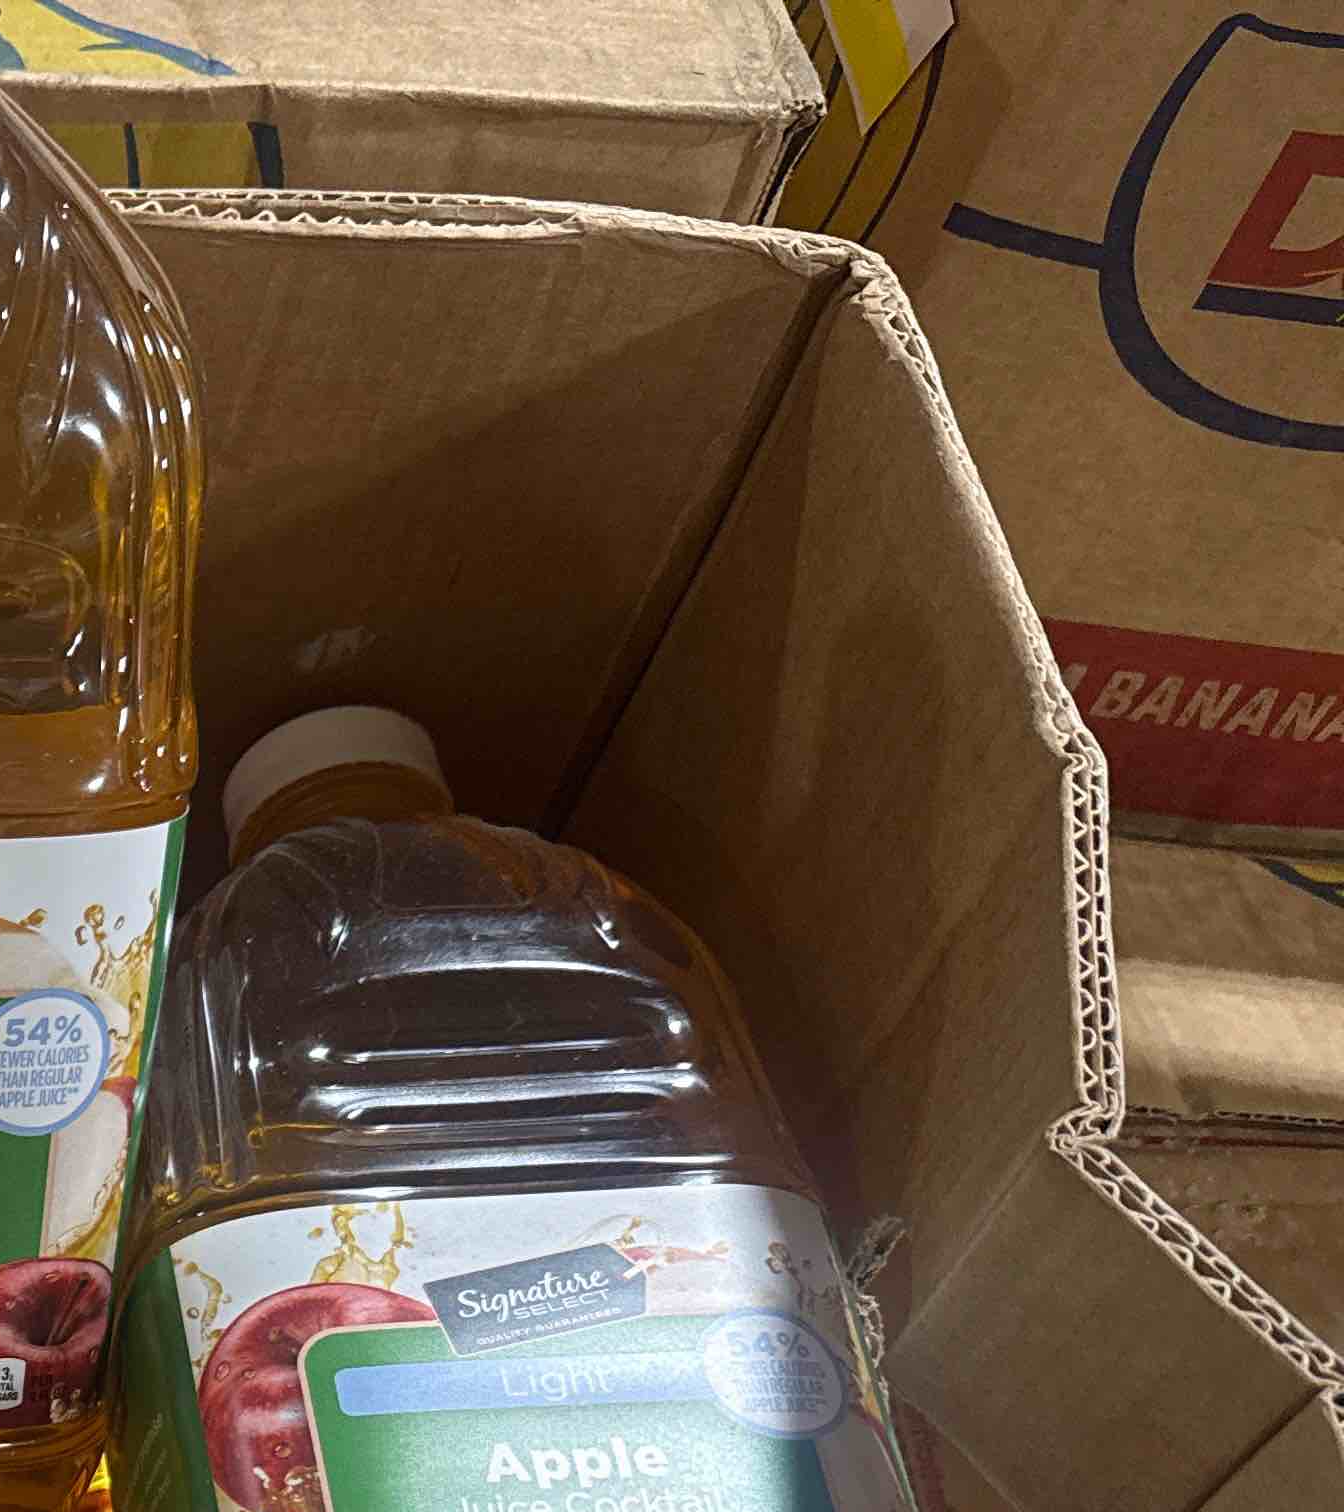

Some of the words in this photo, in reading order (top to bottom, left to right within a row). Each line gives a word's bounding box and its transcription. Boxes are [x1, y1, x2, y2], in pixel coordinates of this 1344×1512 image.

[3, 1015, 81, 1047] 54%
[36, 1044, 89, 1065] CALORIES
[30, 1067, 81, 1086] REGULAR
[458, 1266, 609, 1323] Signature
[512, 1287, 610, 1320] SELECT
[501, 1361, 611, 1400] Light
[485, 1435, 669, 1489] Apple
